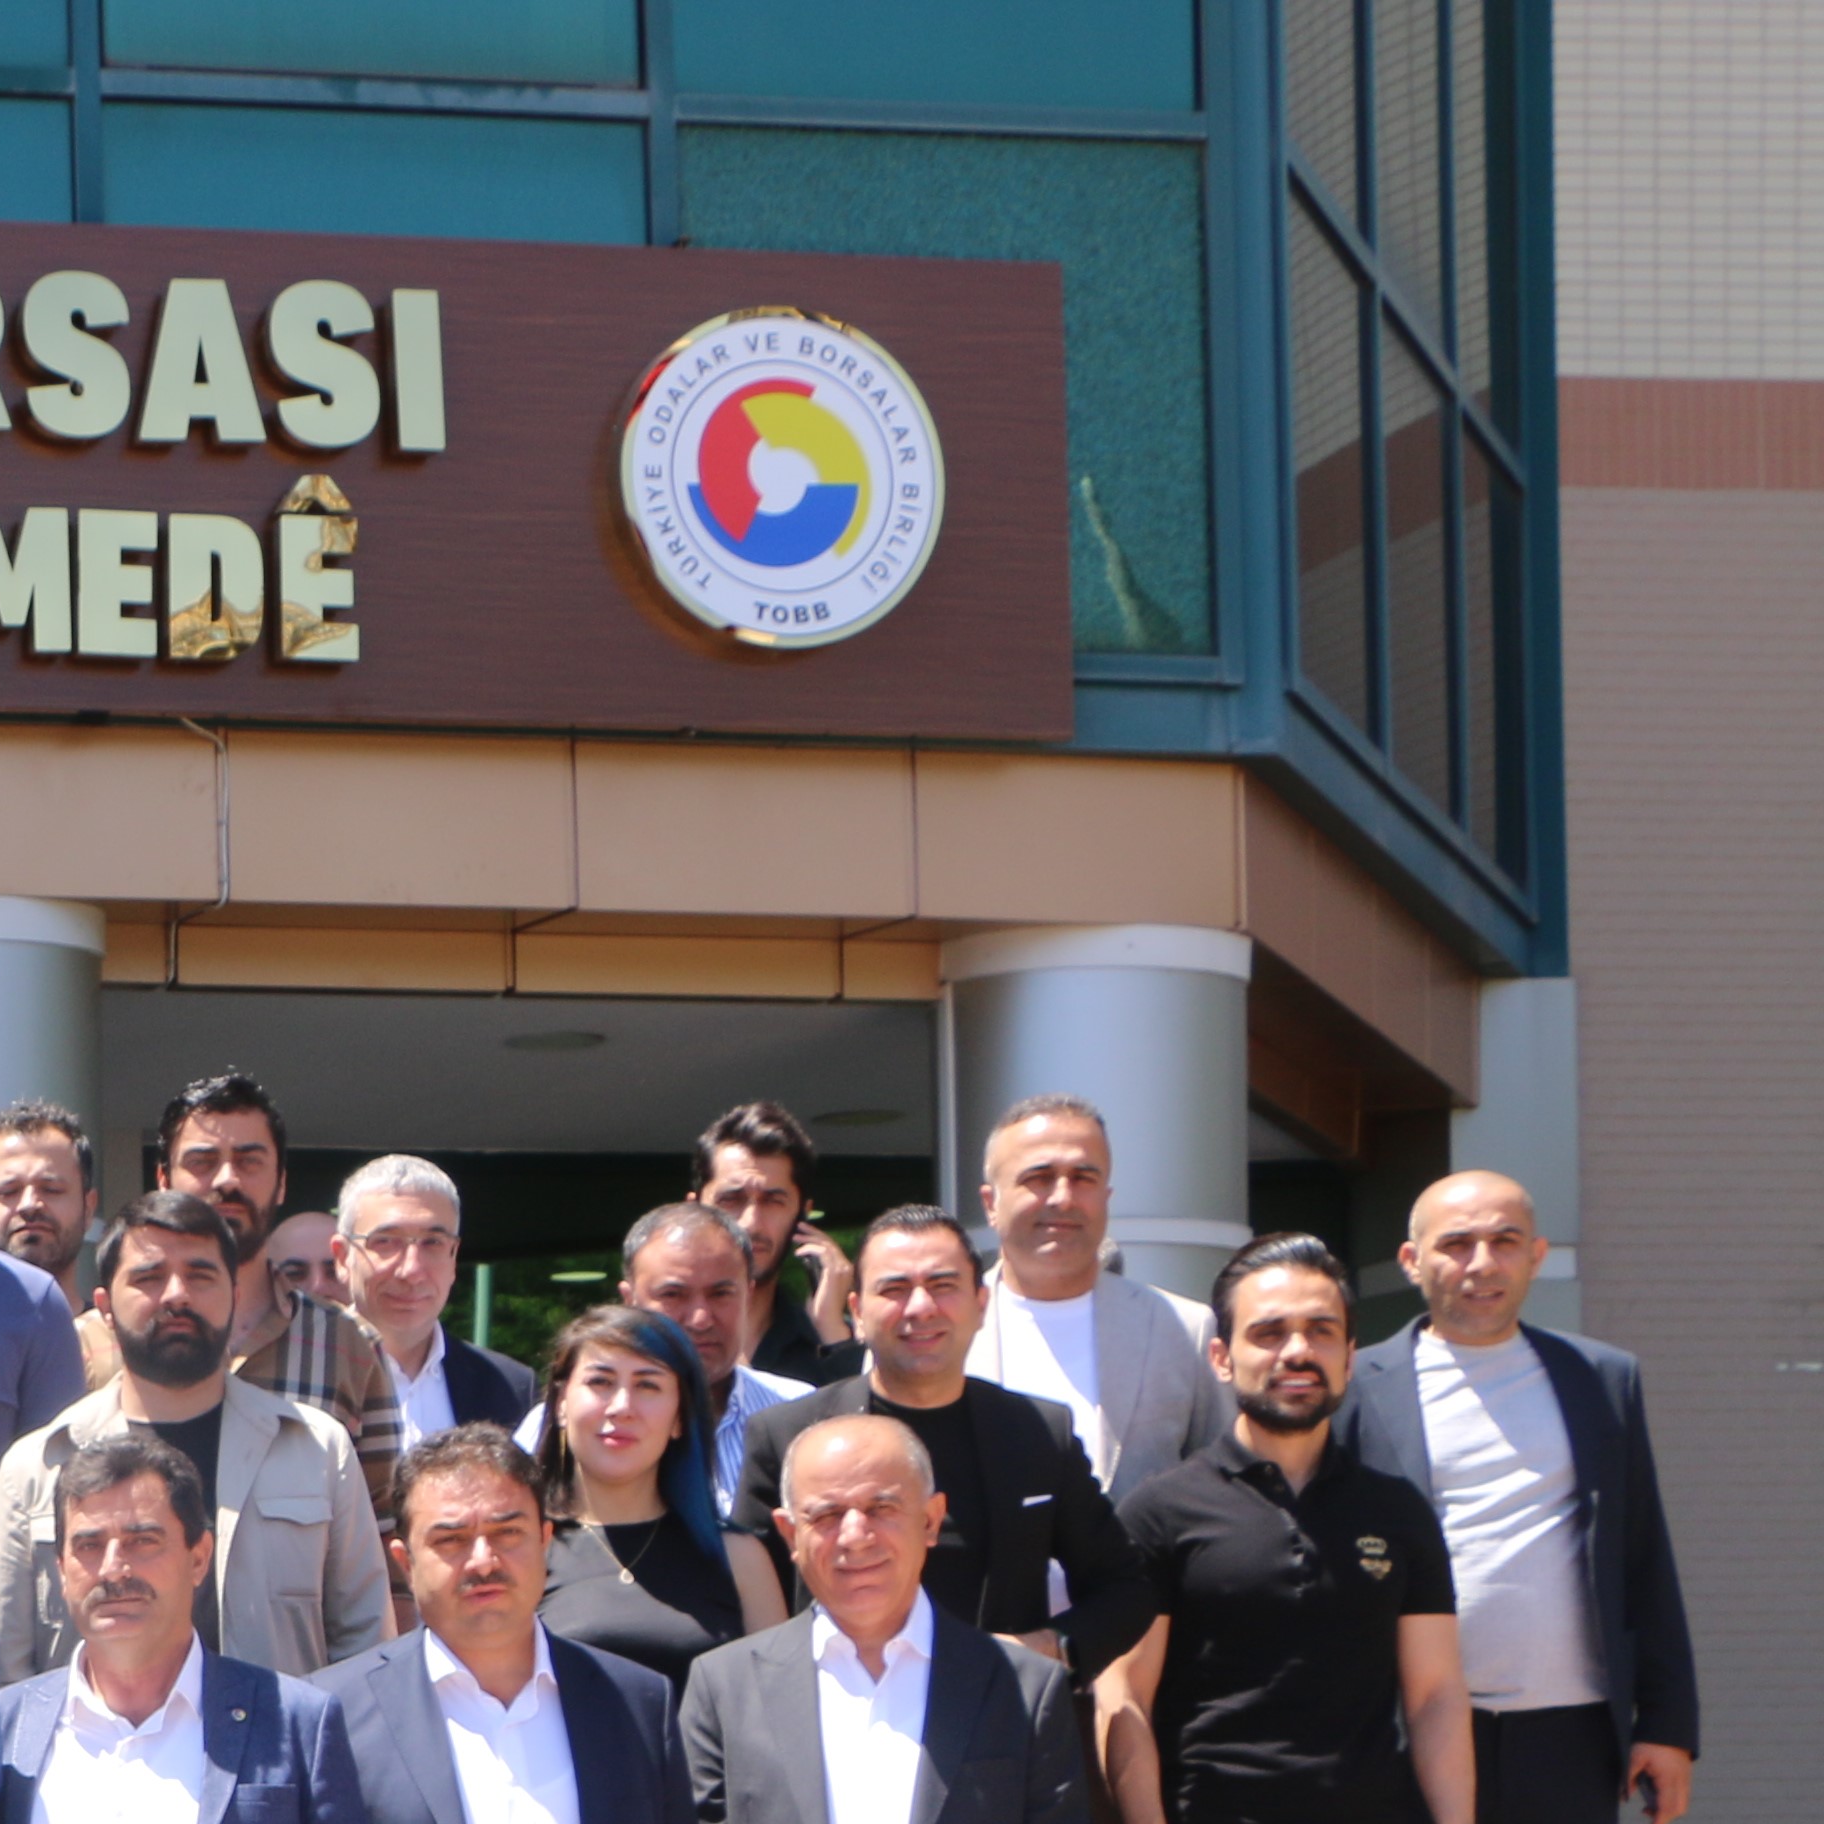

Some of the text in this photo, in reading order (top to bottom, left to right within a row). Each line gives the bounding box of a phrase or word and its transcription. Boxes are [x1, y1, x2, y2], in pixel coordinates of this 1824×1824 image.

[648, 344, 731, 445] ODALAR
[744, 331, 780, 353] VE
[798, 336, 917, 464] BORSALAR
[754, 600, 831, 624] TOBB
